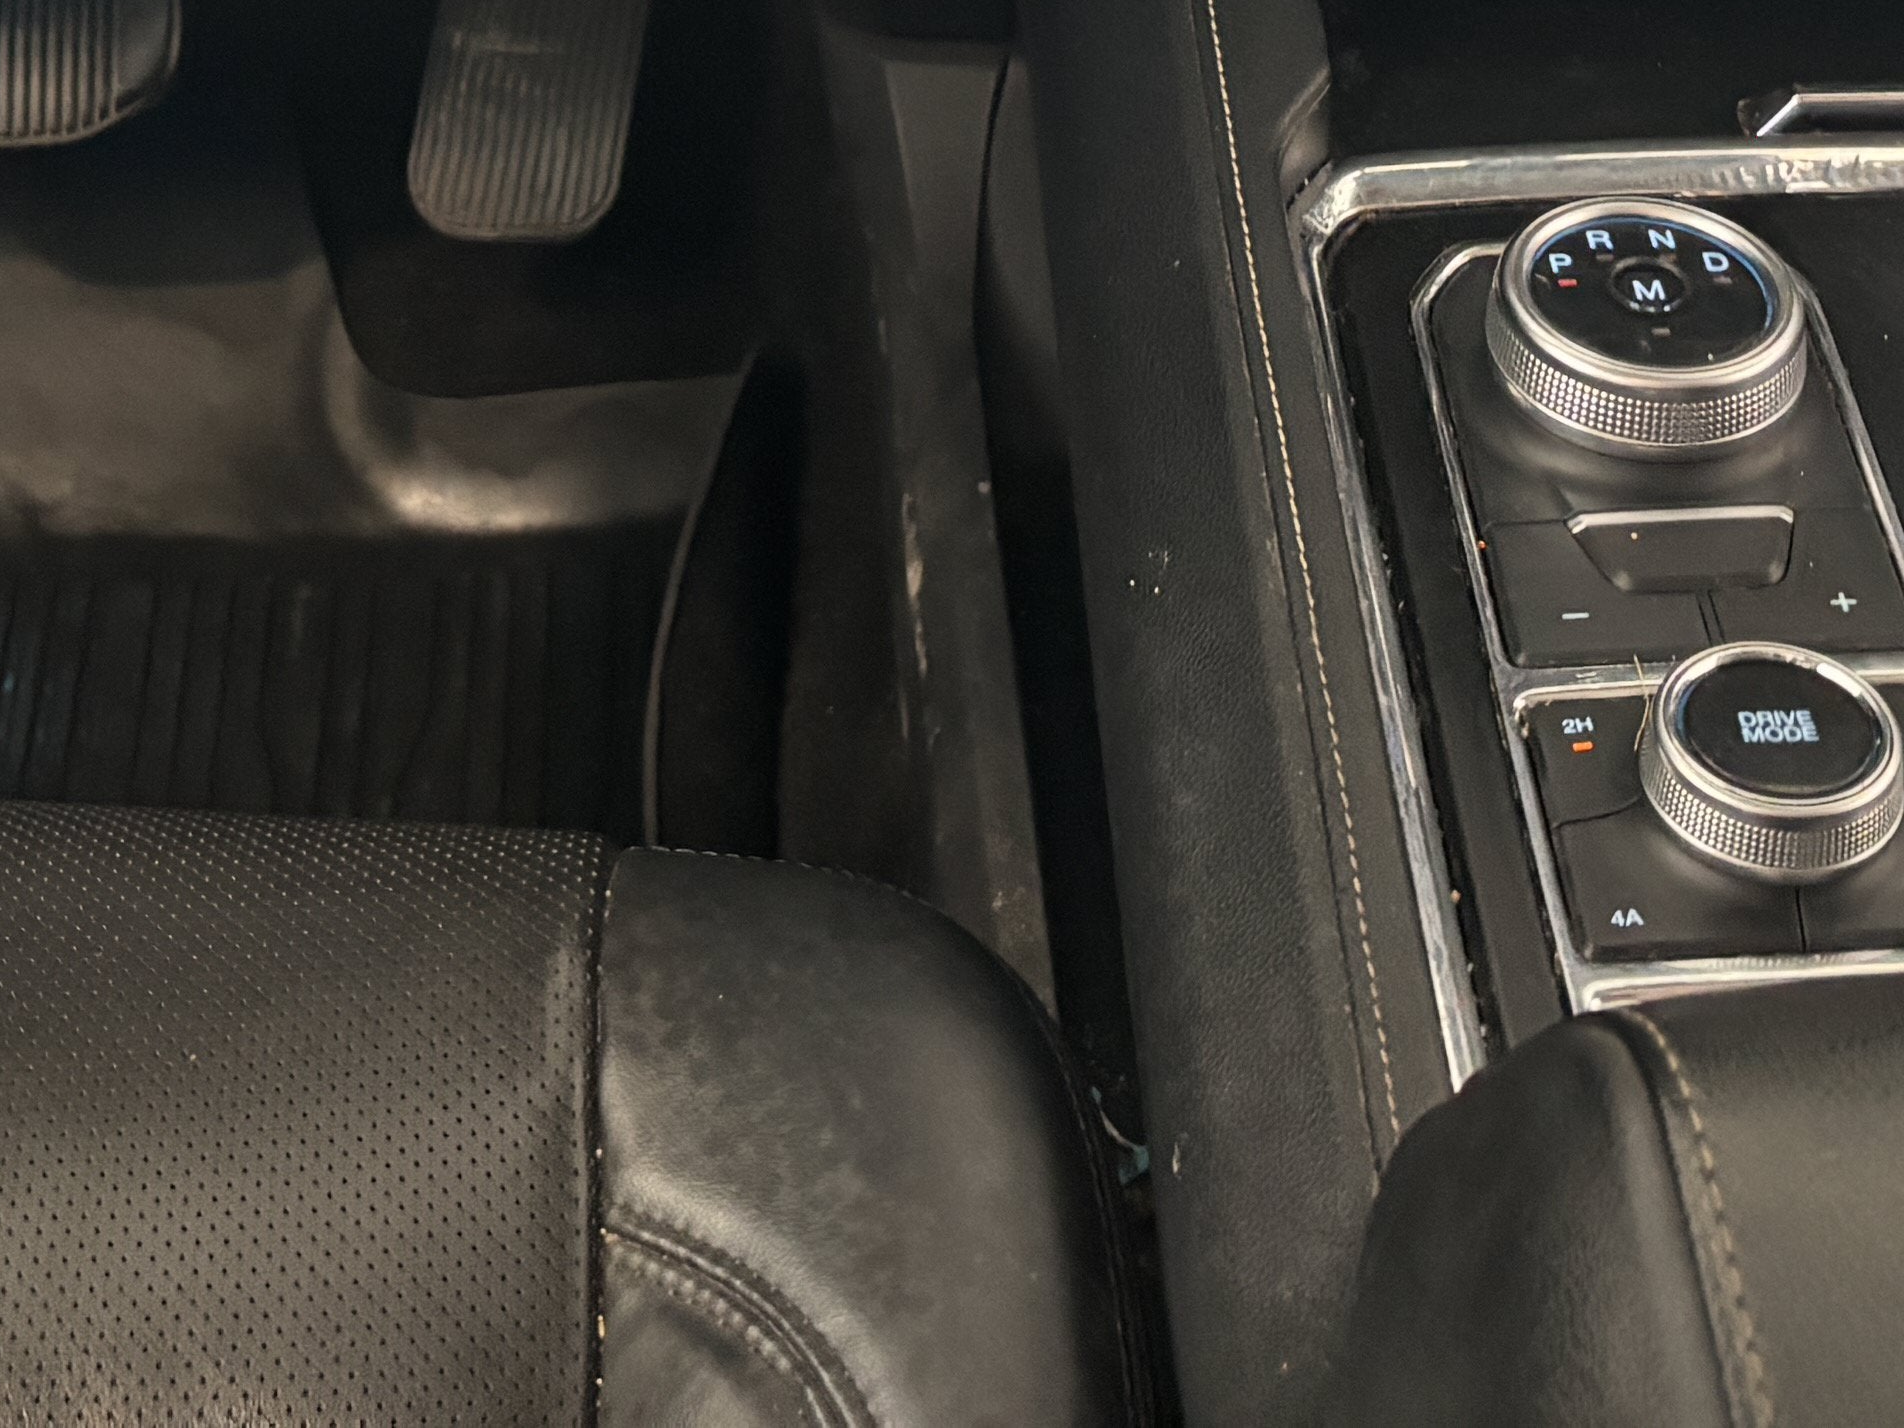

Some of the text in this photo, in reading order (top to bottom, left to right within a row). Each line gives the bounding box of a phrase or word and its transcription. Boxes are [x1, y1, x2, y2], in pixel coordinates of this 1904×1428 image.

[1548, 229, 1730, 274] P R N D
[1632, 280, 1667, 301] M
[1562, 716, 1594, 734] 2H
[1736, 709, 1813, 729] DRIVE
[1741, 724, 1820, 744] MODE
[1610, 908, 1644, 928] 4A
